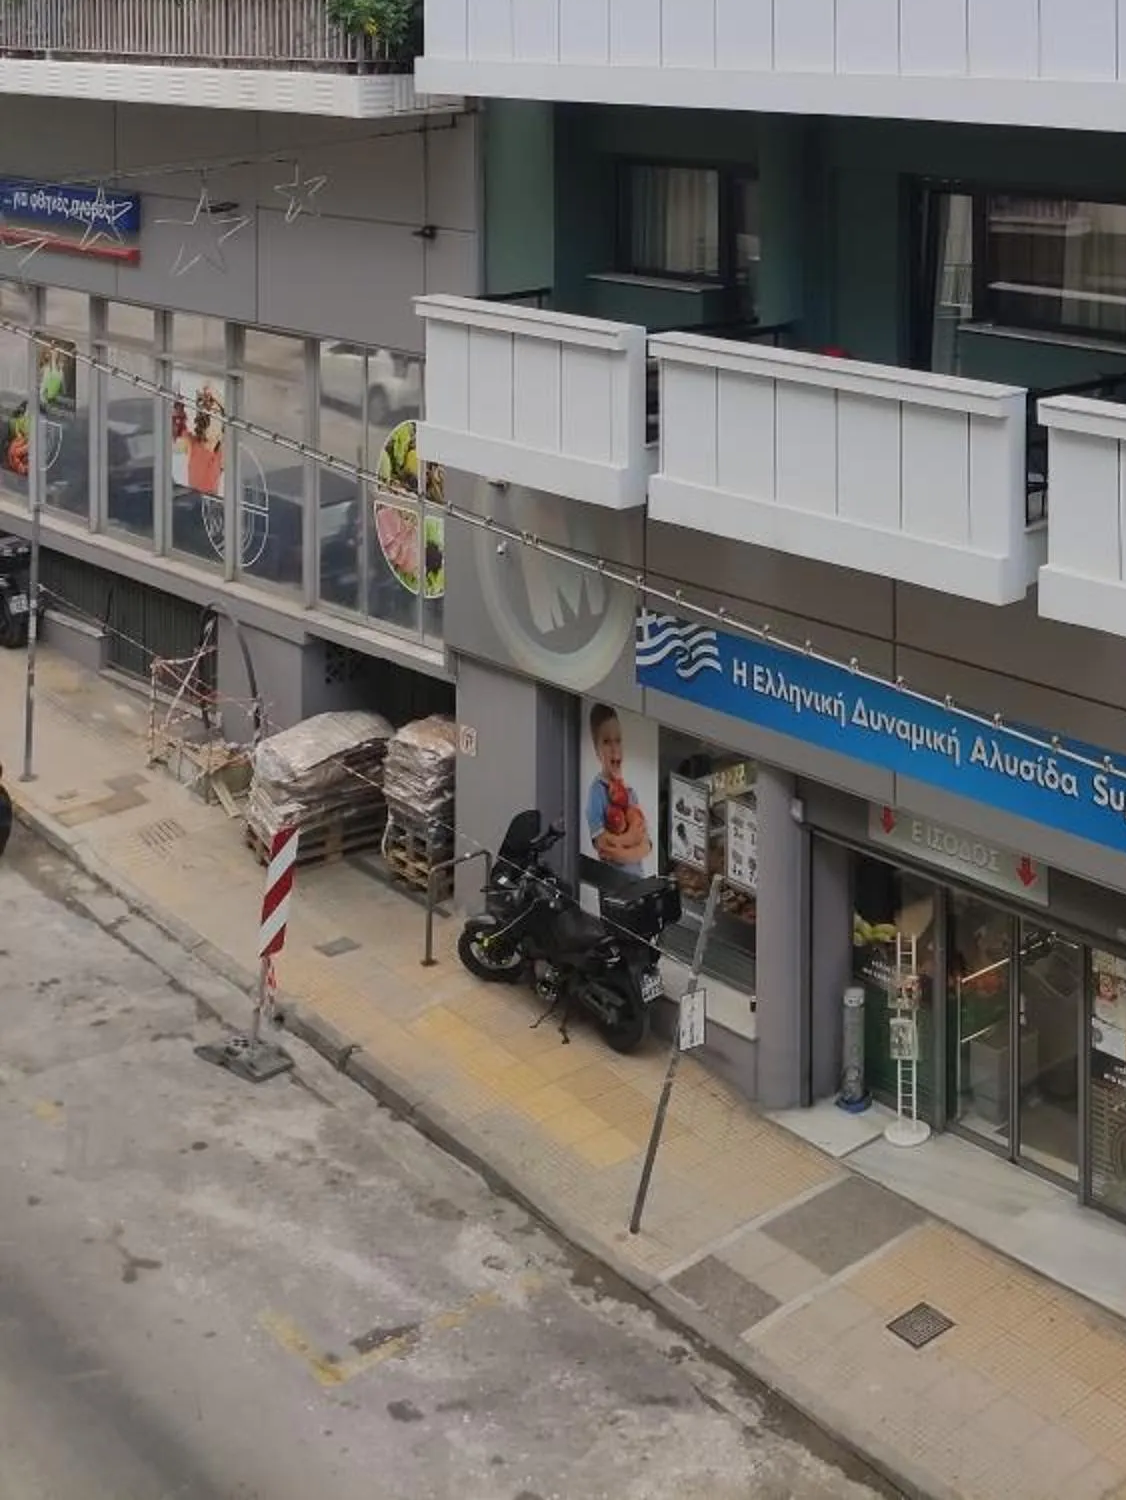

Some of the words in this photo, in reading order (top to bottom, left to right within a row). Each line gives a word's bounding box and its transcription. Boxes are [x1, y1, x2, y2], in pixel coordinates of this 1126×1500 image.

[733, 657, 747, 687] Η
[753, 663, 845, 728] Ελληνική
[851, 697, 960, 767] Δυναμική
[969, 735, 1079, 798] Αλυσίδα
